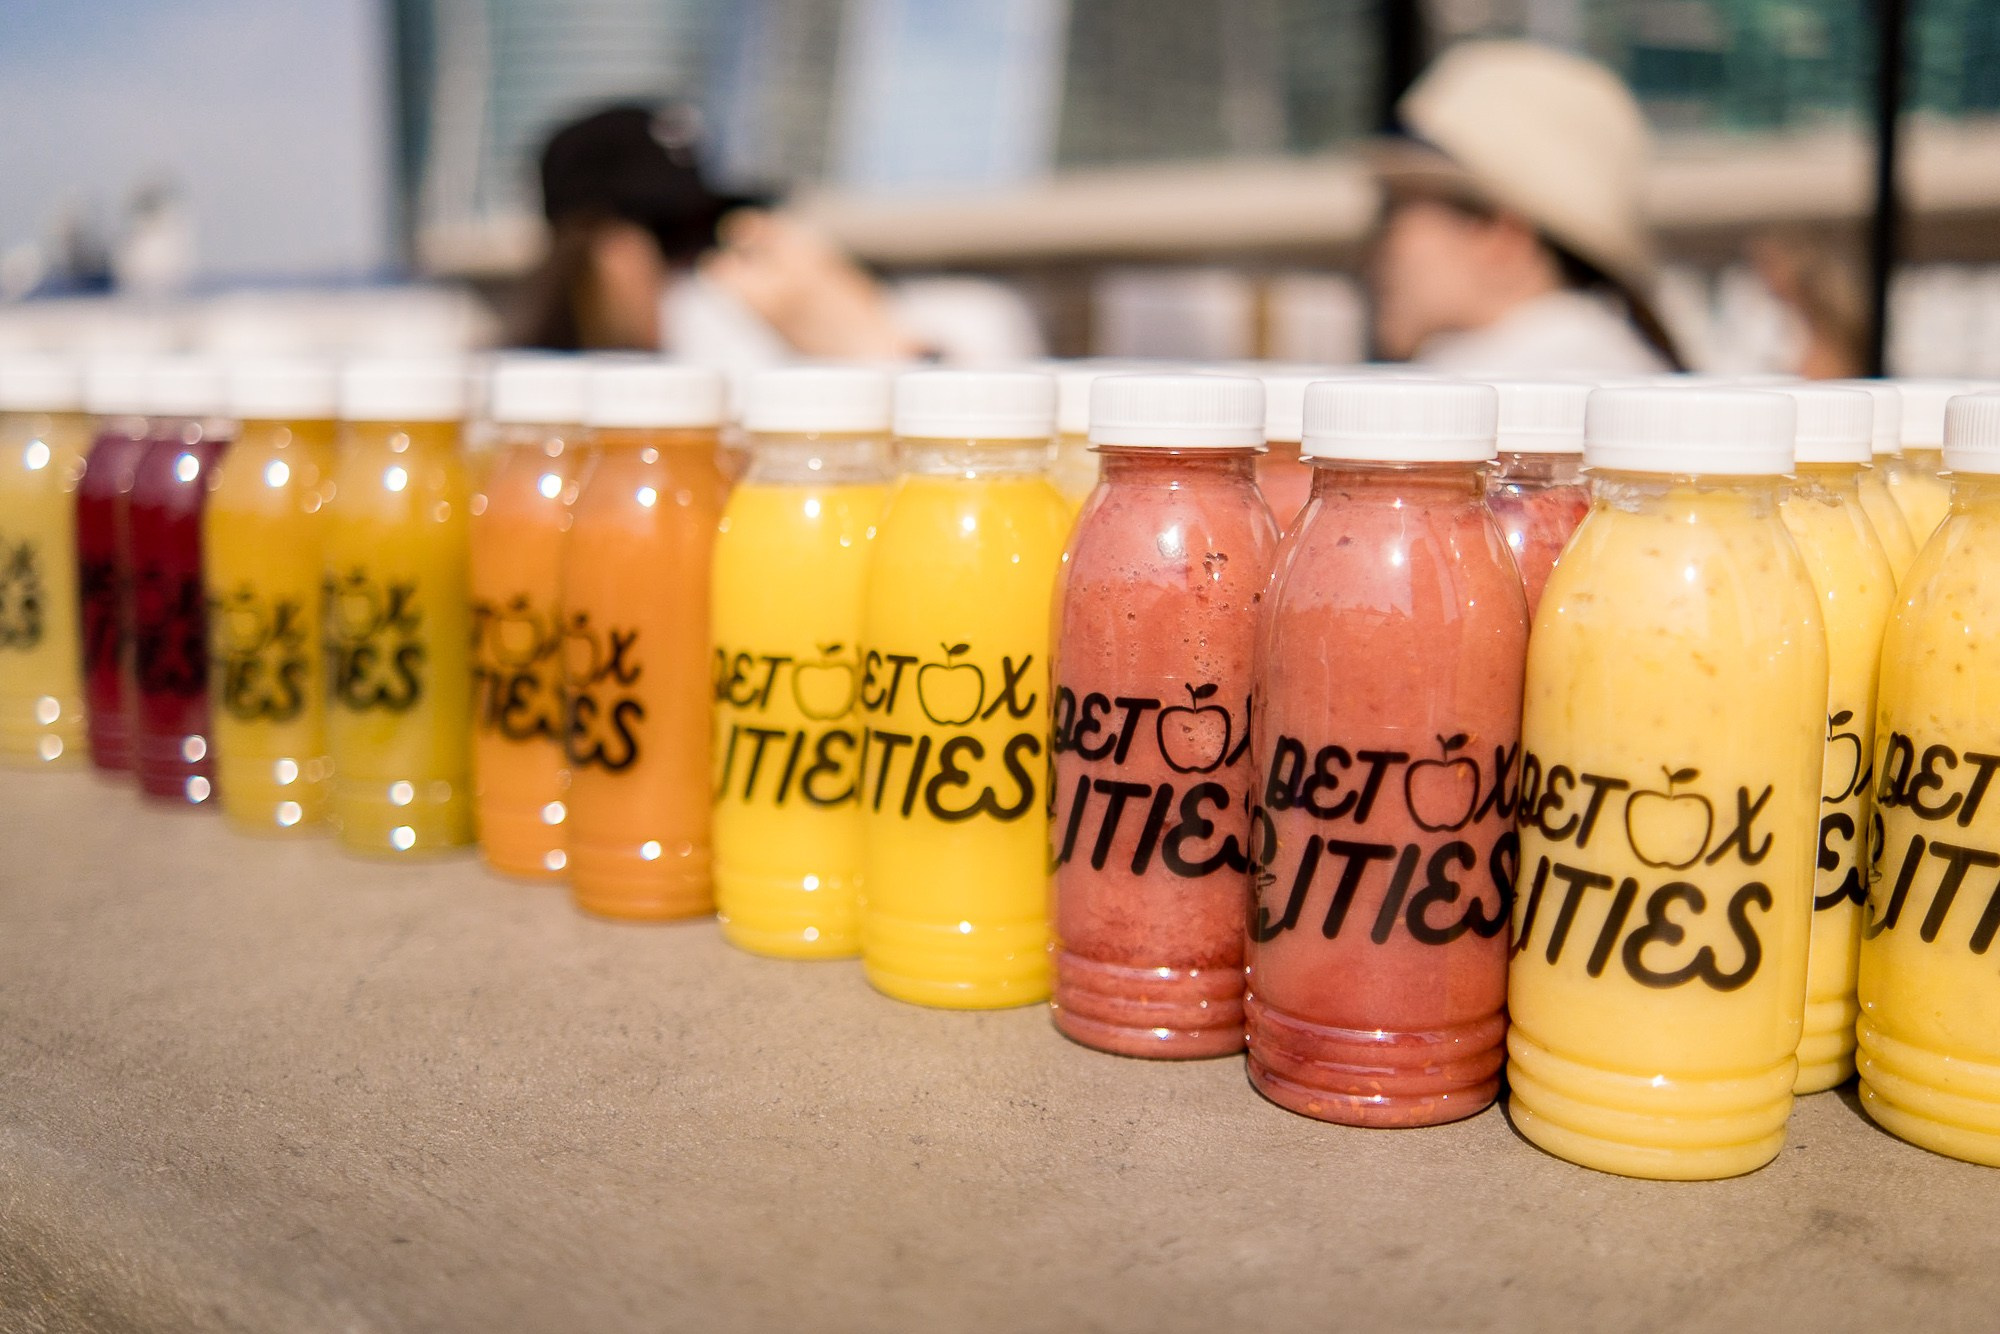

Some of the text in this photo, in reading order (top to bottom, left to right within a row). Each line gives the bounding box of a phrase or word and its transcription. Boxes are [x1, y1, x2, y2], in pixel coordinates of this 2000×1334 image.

[855, 642, 1037, 726] ETOX
[856, 727, 1042, 823] ITIES
[1876, 730, 2000, 828] DET
